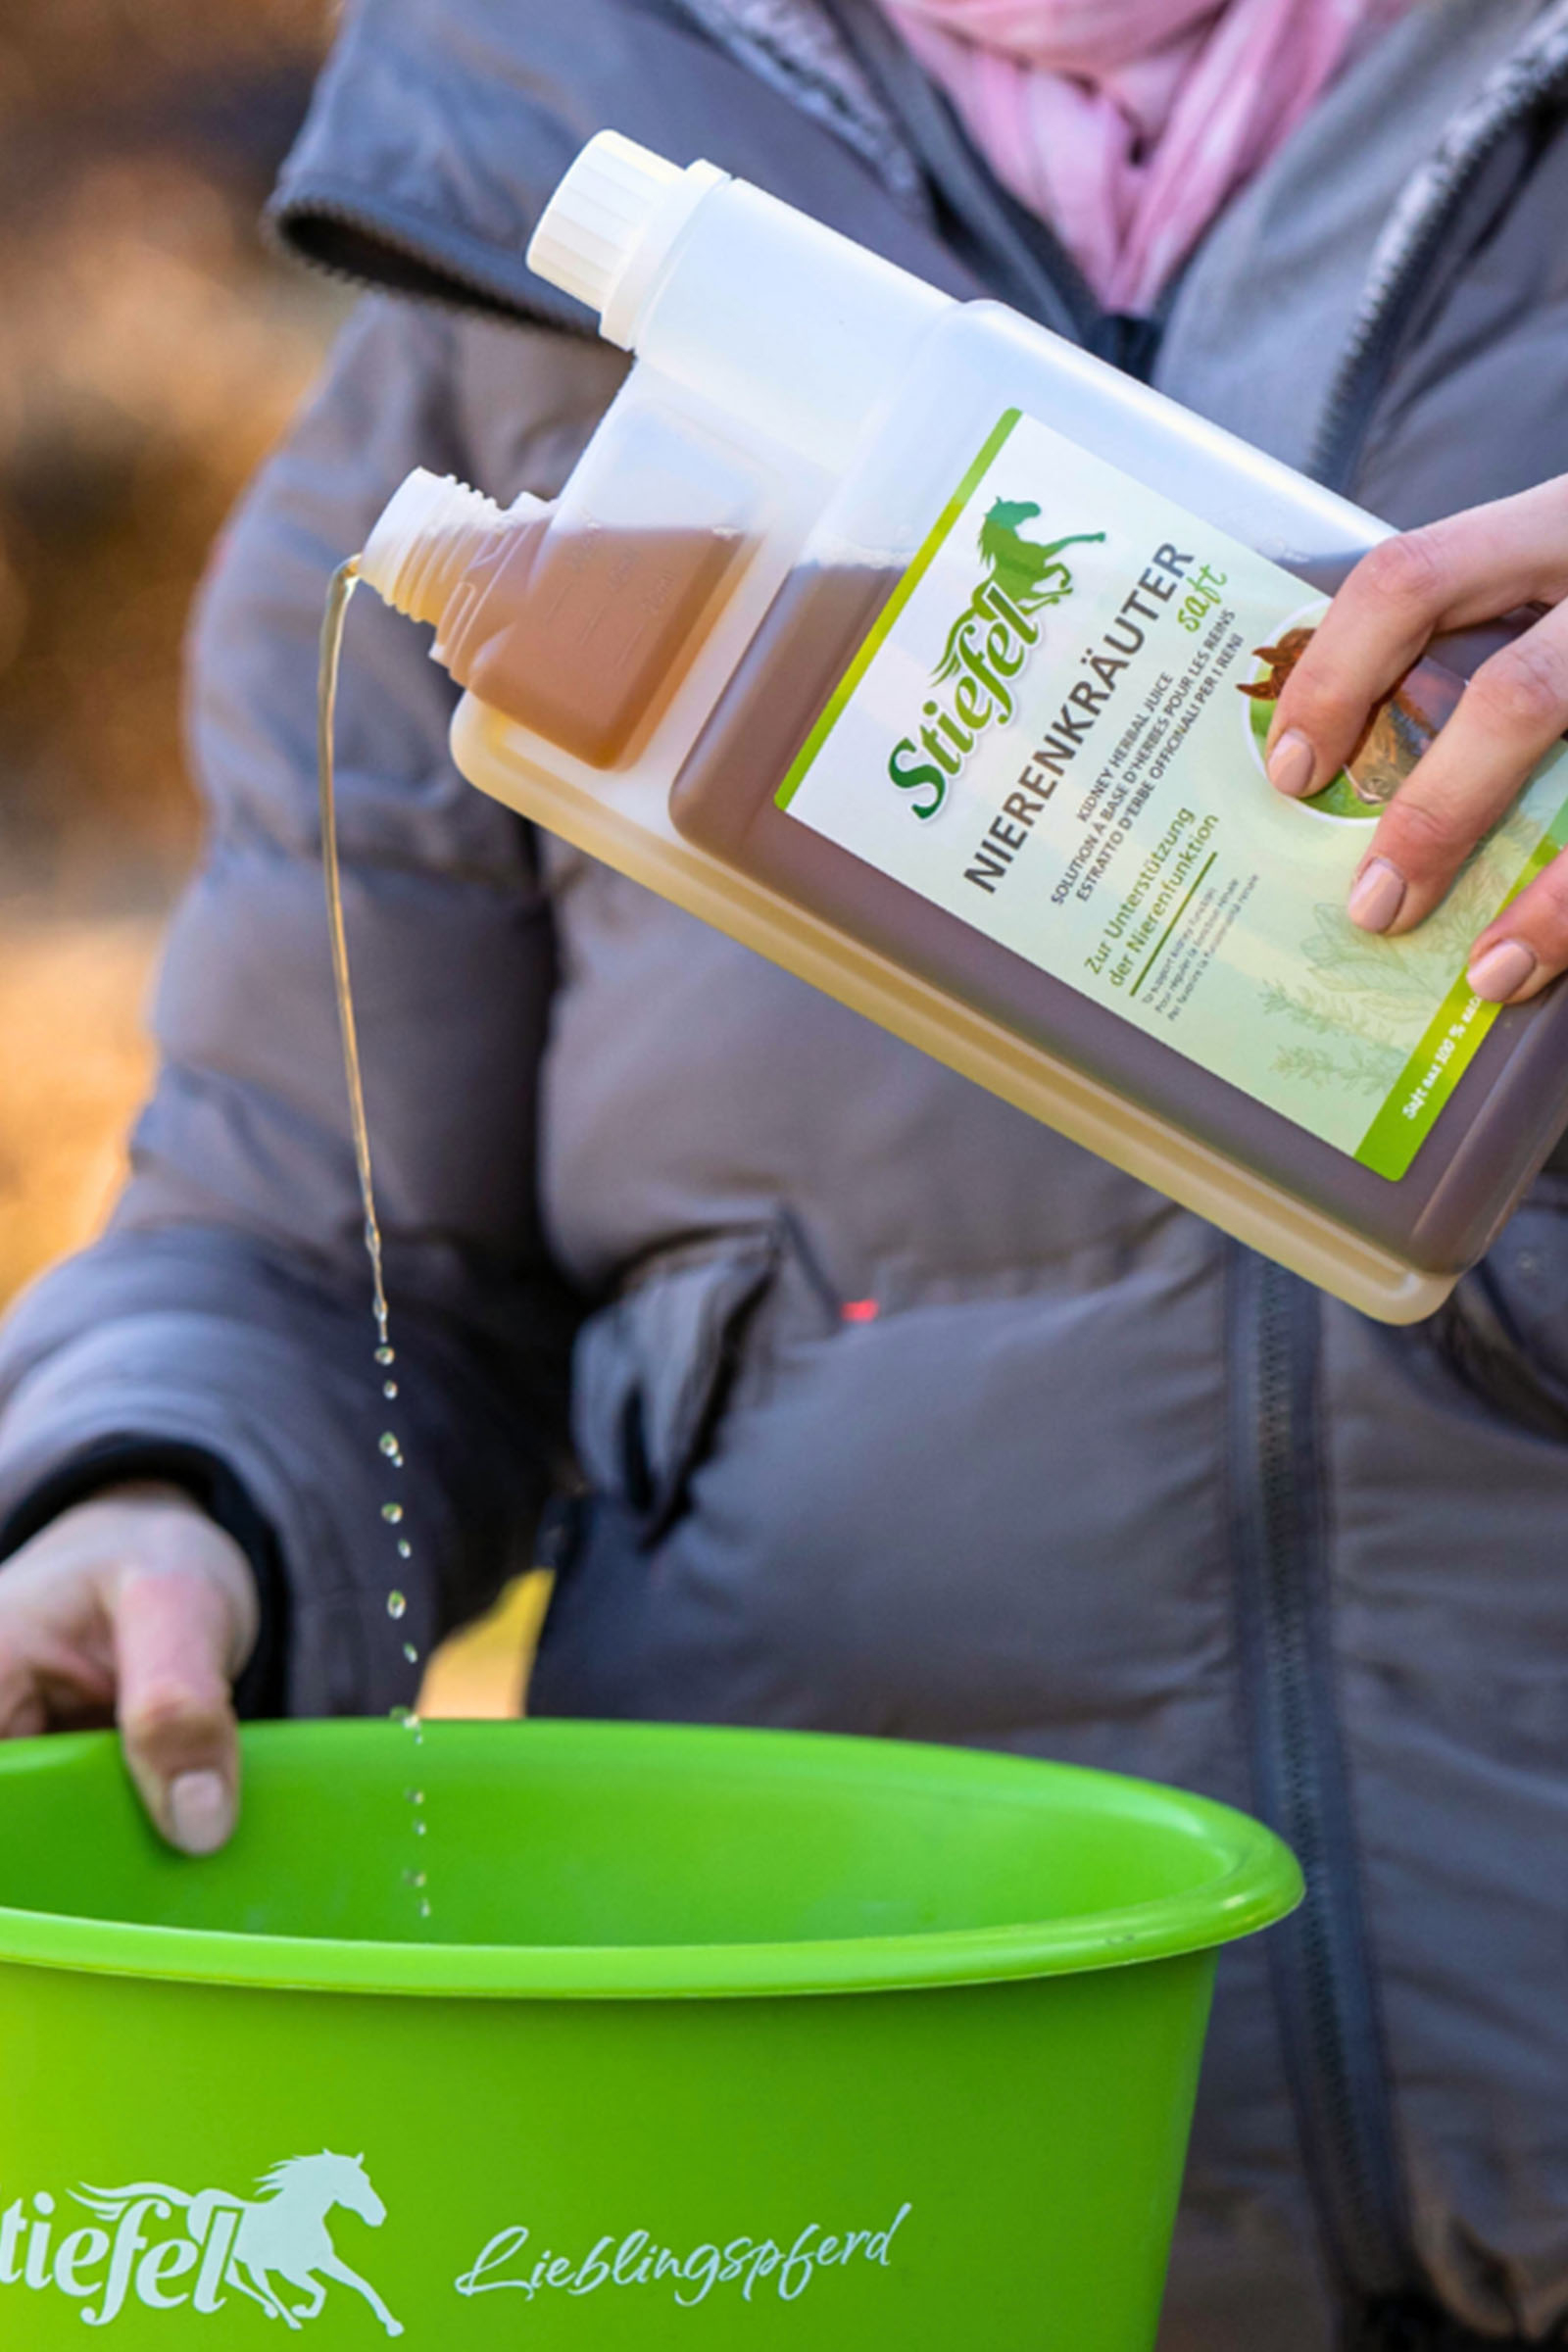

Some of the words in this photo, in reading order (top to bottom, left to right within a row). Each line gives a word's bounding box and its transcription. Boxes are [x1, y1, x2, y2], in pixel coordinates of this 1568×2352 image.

[1173, 561, 1231, 635] saft
[888, 584, 1039, 818] Stiefel
[962, 544, 1192, 893] NIERENKRÄUTER
[1050, 833, 1100, 906] SOLUTION
[1099, 782, 1130, 822] BASE
[1121, 714, 1170, 785] D'HERBES
[1162, 674, 1196, 717] POUR
[1187, 648, 1211, 677] LES
[1201, 607, 1236, 652] REINS
[1075, 766, 1115, 822] KIDNEY
[1107, 710, 1150, 768] HERBAL
[1143, 671, 1173, 711] JUICE
[1075, 829, 1125, 902] ESTRATTO
[1116, 778, 1155, 831] D'ERBE
[1147, 702, 1202, 781] OFFICINALI
[1193, 674, 1218, 705] PER
[1215, 632, 1245, 669] RENI
[1082, 939, 1114, 975] Zur
[1103, 805, 1197, 943] Unterstützung
[1104, 952, 1137, 989] der
[1125, 809, 1220, 955] Nierenfunktion
[0, 2191, 238, 2326] tiefel
[455, 2202, 911, 2306] Lieblingspferd
